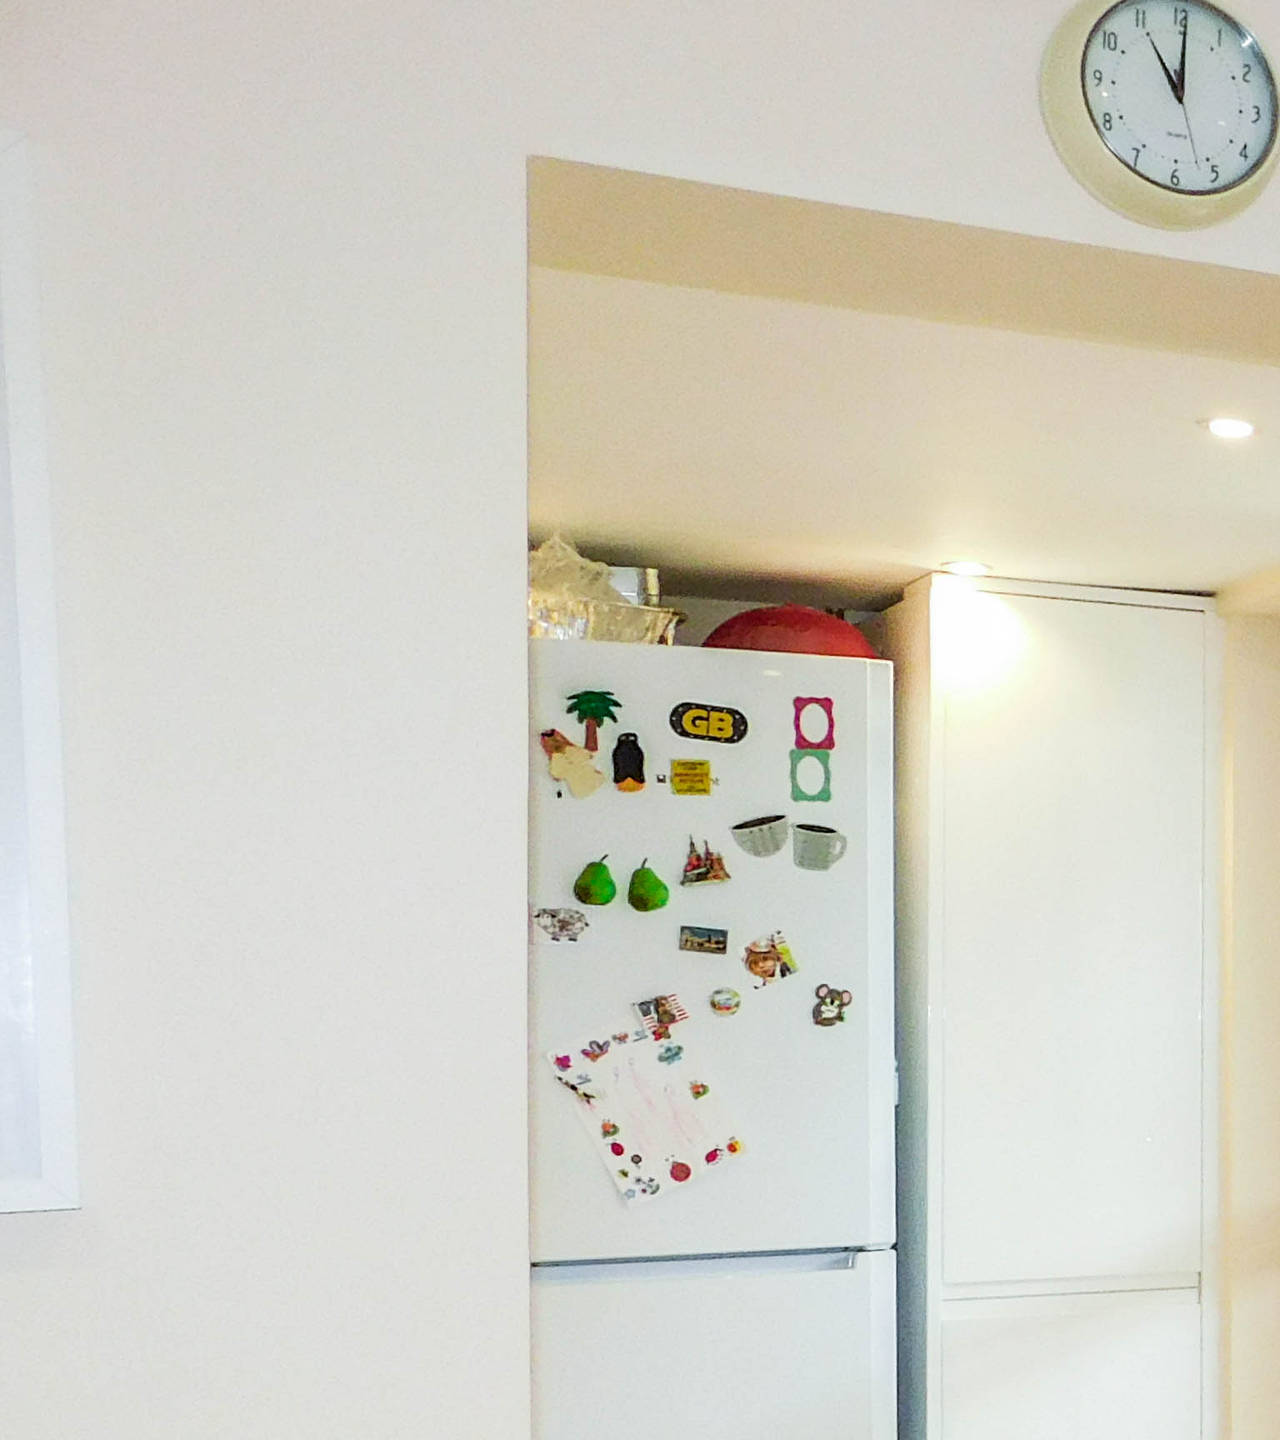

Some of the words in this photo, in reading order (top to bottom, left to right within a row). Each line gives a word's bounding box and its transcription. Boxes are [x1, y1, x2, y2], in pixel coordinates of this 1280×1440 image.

[1134, 8, 1146, 29] 11
[1173, 8, 1188, 28] 12
[1102, 31, 1118, 51] 10
[1093, 70, 1102, 87] 9
[1242, 64, 1252, 83] 2
[1103, 112, 1113, 132] 8
[1251, 105, 1261, 123] 3
[1132, 147, 1140, 168] 7
[1239, 143, 1249, 161] 4
[1170, 168, 1180, 186] 6
[1210, 165, 1219, 183] 5
[682, 708, 734, 739] GB
